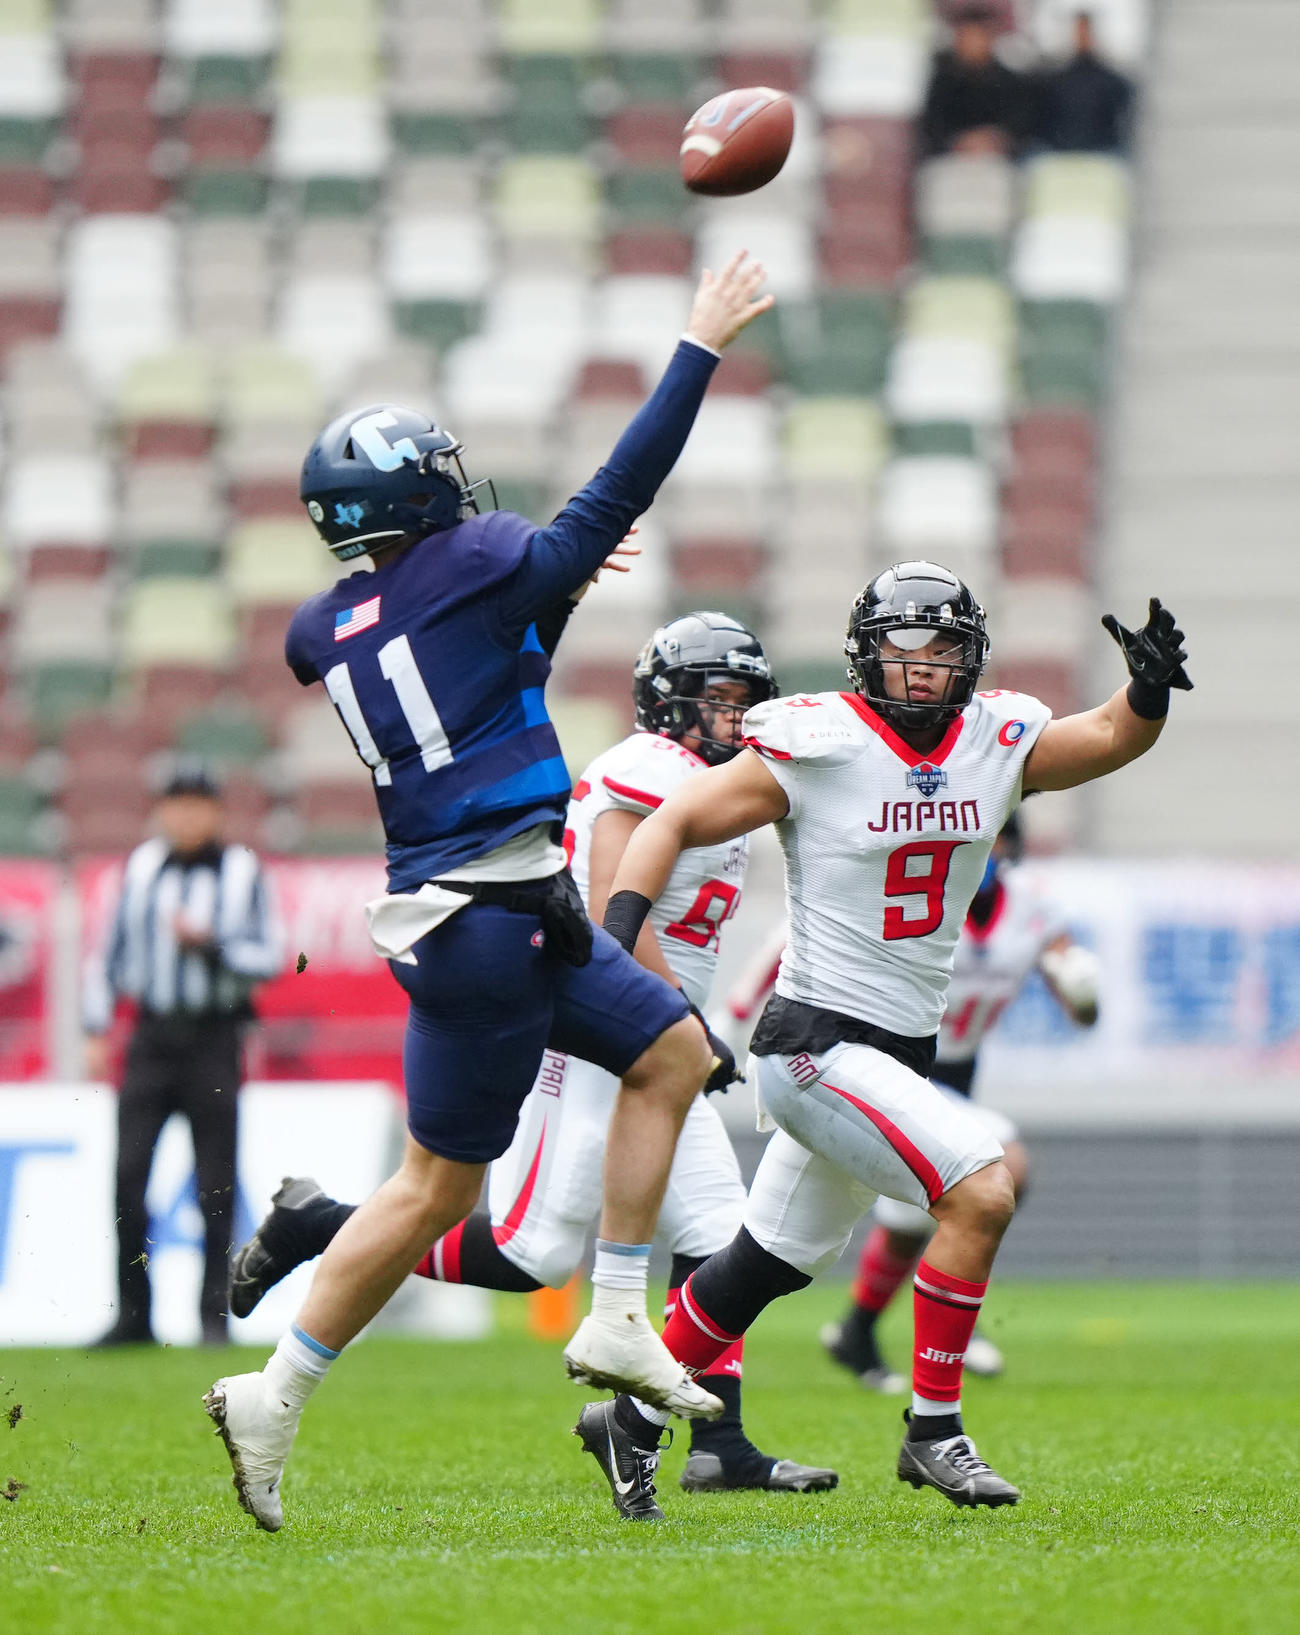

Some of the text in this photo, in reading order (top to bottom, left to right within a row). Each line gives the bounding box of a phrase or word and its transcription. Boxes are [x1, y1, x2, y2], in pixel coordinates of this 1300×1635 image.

[324, 634, 455, 786] 11
[867, 799, 980, 832] JAPAN
[882, 840, 972, 941] 9
